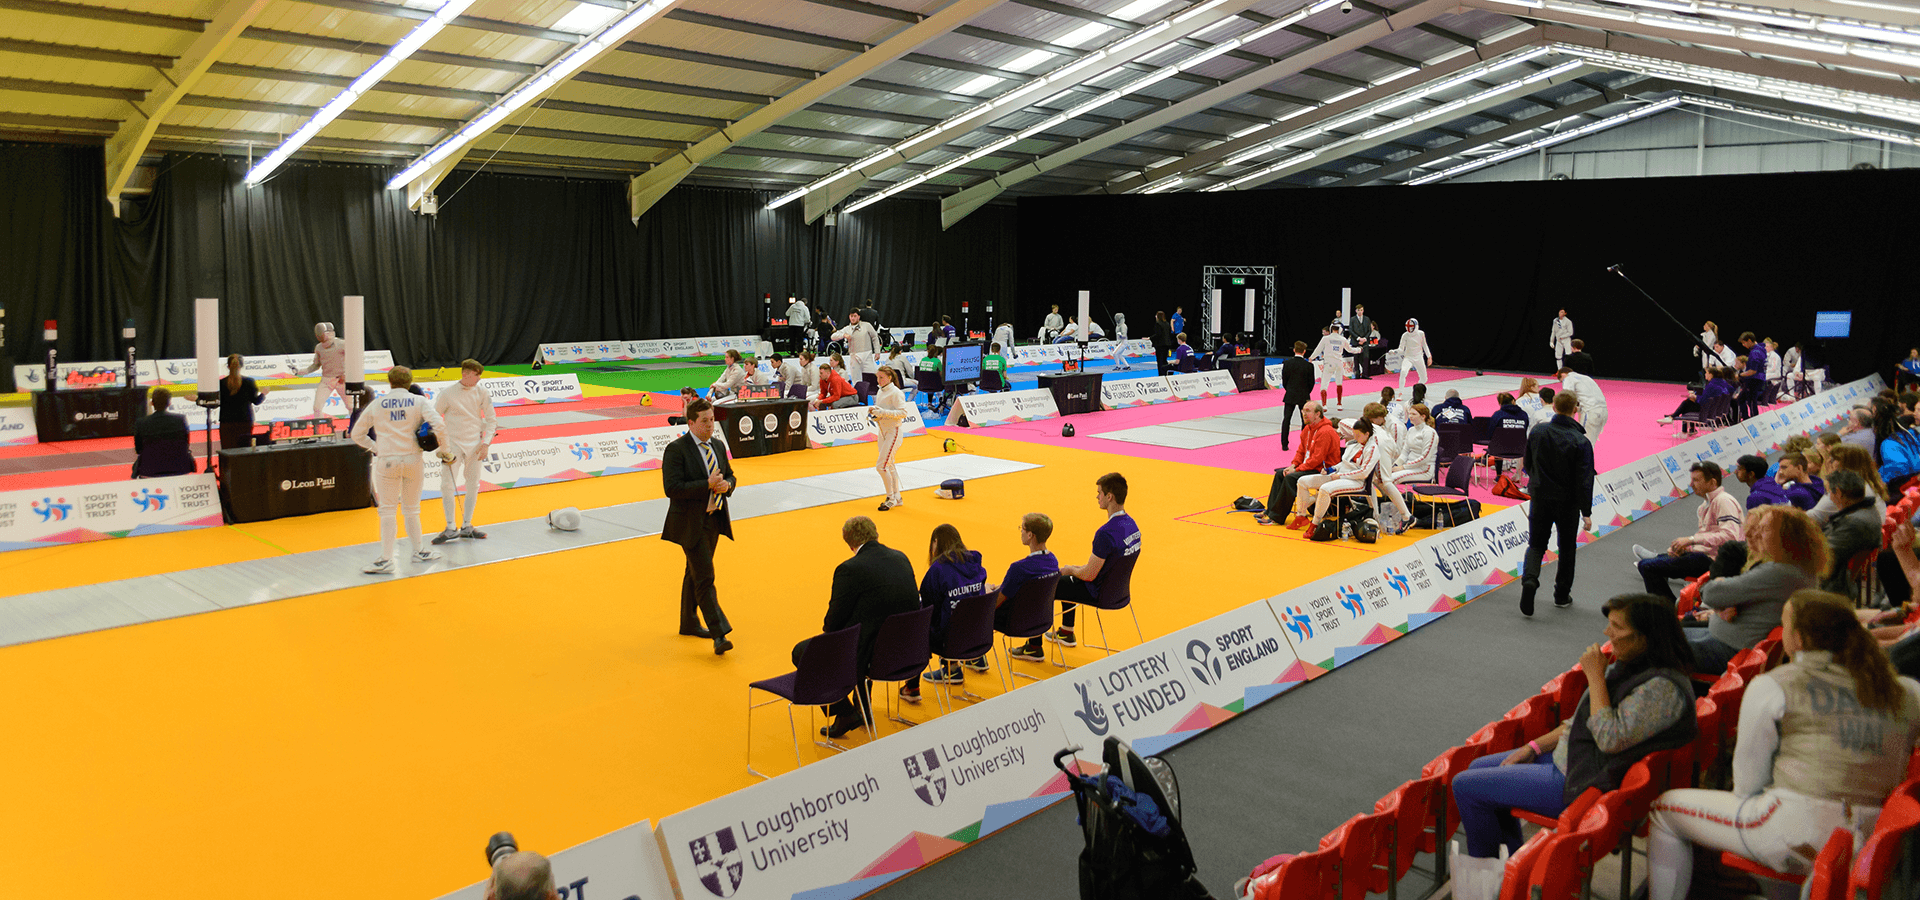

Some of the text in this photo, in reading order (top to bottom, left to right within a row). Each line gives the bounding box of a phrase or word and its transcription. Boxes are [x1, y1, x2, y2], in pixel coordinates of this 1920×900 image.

[484, 381, 516, 390] OTTERY
[541, 379, 564, 387] SPORT
[544, 384, 575, 393] ENGLAND
[1109, 382, 1131, 391] LOTTERY
[1145, 381, 1160, 389] SPORT
[1112, 390, 1135, 400] FUNDED
[1148, 387, 1168, 395] ENGLAND
[381, 398, 415, 410] GIRVIN
[390, 410, 407, 422] NIR
[825, 412, 859, 423] LOTTERY
[829, 422, 865, 435] FUNDED
[598, 440, 620, 449] YOUTH
[651, 434, 671, 442] YOUTH
[501, 446, 562, 463] Loughborough
[600, 445, 619, 455] SPORT
[602, 452, 621, 460] TRUST
[504, 457, 547, 470] University
[179, 484, 211, 493] YOUTH
[292, 476, 336, 489] Leon Paul
[84, 493, 118, 502] YOUTH
[180, 492, 209, 501] SPORT
[0, 503, 17, 511] UTH
[84, 501, 117, 511] SPORT
[181, 499, 210, 509] TRUST
[86, 509, 117, 519] TRUST
[1497, 521, 1517, 538] SPORT
[1442, 532, 1477, 557] LOTTERY
[1504, 530, 1530, 550] ENGLAND
[1404, 559, 1423, 572] YOUTH
[1453, 551, 1489, 578] FUNDED
[1410, 569, 1428, 582] SPORT
[1359, 576, 1380, 590] YOUTH
[1416, 579, 1433, 591] TRUST
[1366, 586, 1385, 601] SPORT
[1309, 596, 1331, 610] YOUTH
[1371, 597, 1390, 611] TRUST
[1315, 606, 1336, 622] SPORT
[1321, 618, 1341, 633] TRUST
[1215, 627, 1255, 653] SPORT
[1225, 637, 1280, 672] ENGLAND
[1098, 651, 1171, 698] LOTTERY
[1112, 679, 1187, 728] FUNDED
[940, 708, 1046, 763] Loughborough
[950, 745, 1026, 787] University
[740, 773, 881, 843] Loughborough
[750, 818, 850, 872] University
